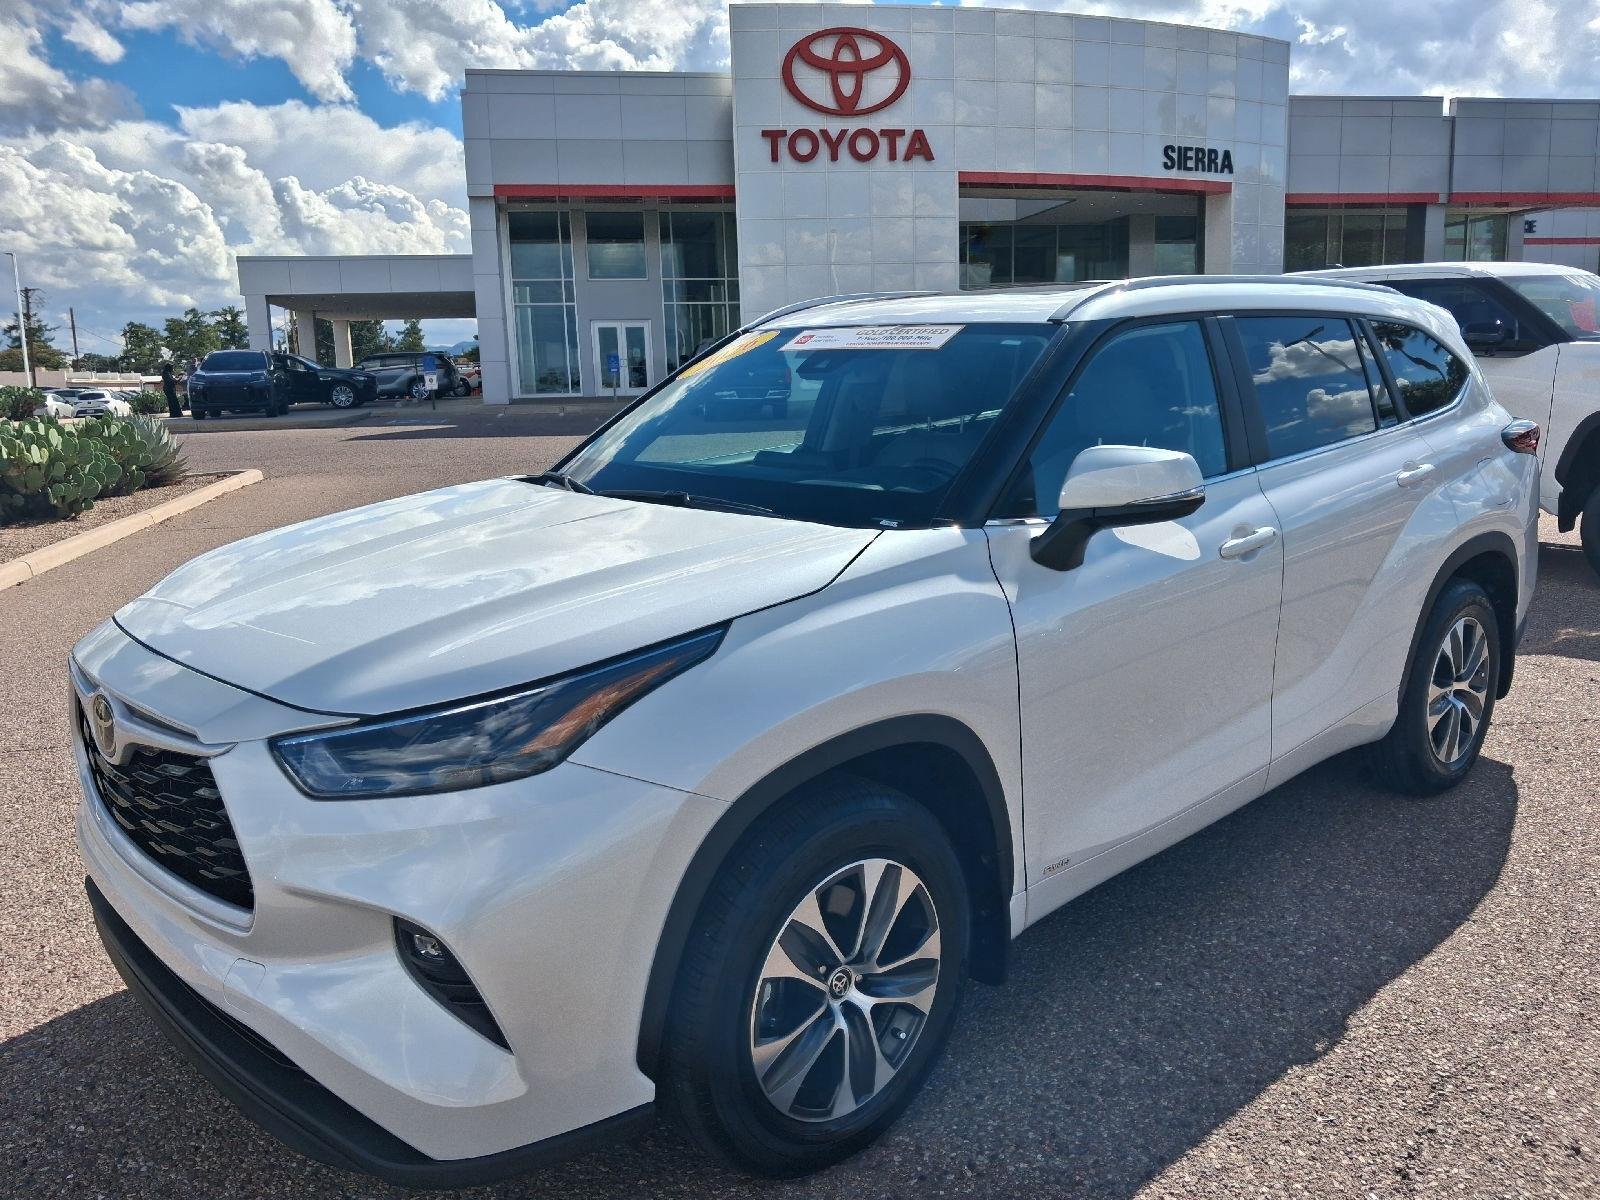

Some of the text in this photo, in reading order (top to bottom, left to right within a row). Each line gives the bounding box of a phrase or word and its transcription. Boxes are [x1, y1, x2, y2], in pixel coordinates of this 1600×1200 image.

[761, 127, 936, 163] TOYOTA
[1163, 144, 1234, 174] SIERRA
[889, 327, 950, 335] CERTIFIED
